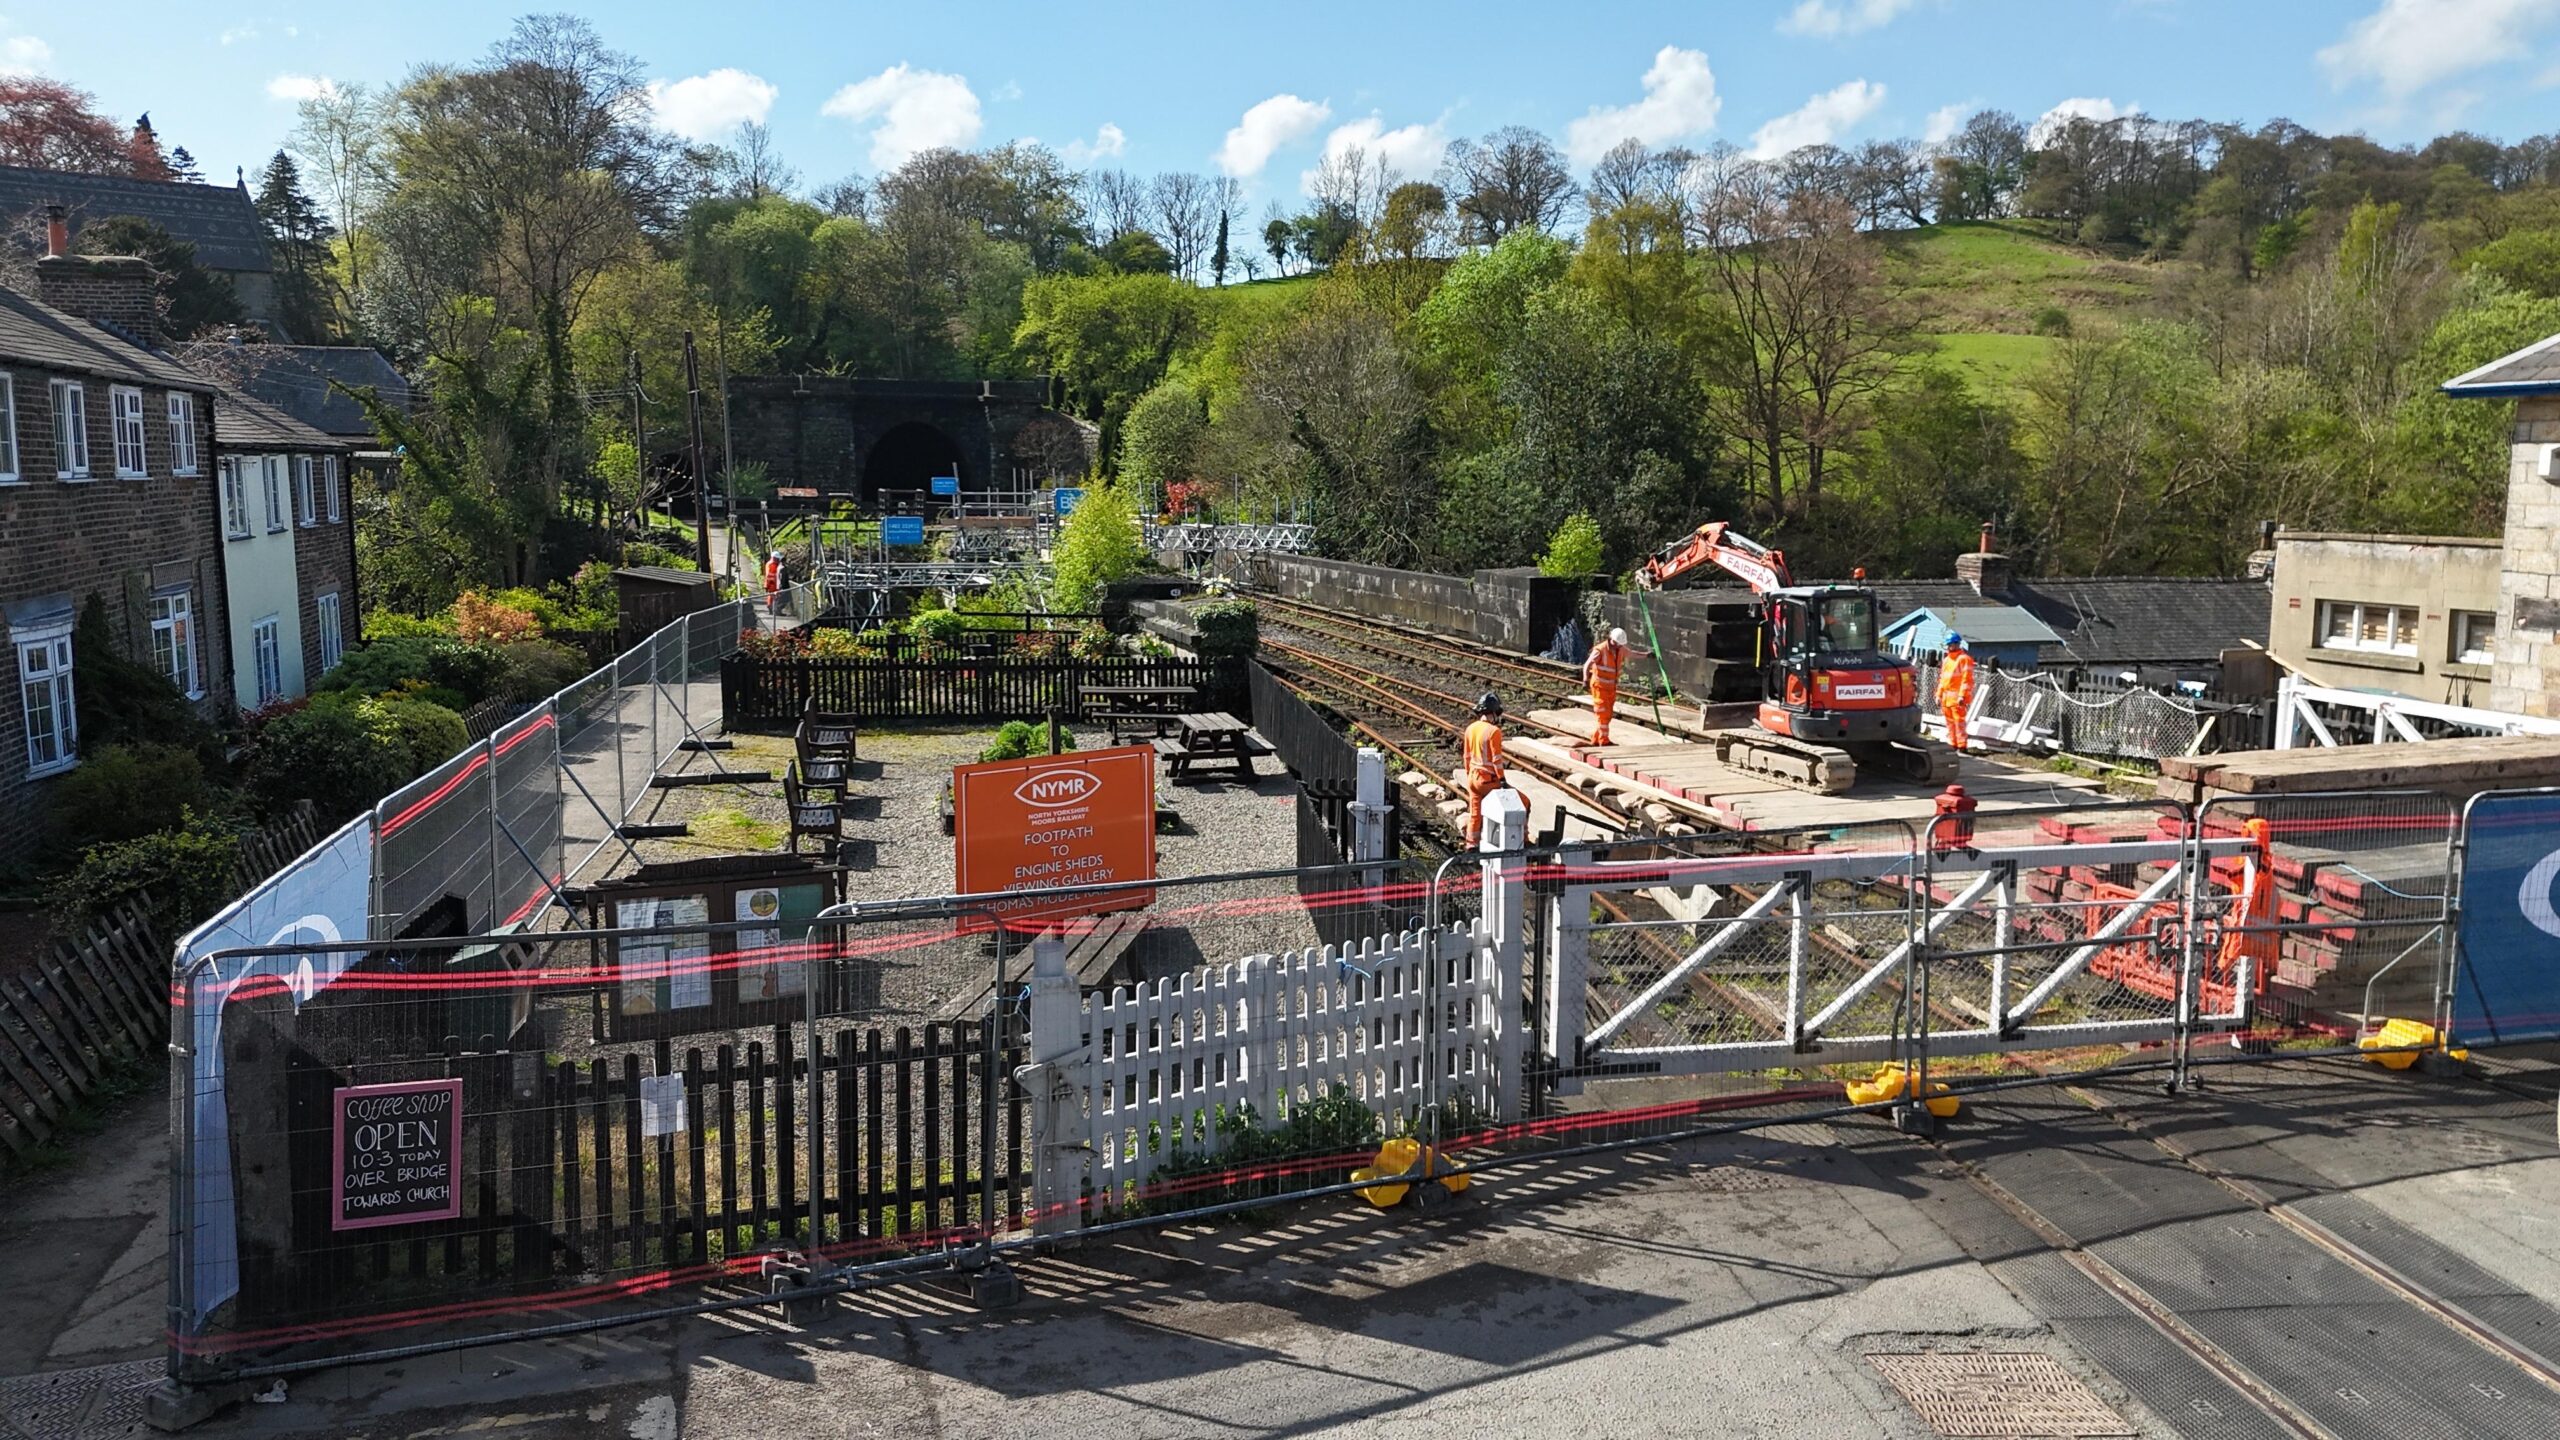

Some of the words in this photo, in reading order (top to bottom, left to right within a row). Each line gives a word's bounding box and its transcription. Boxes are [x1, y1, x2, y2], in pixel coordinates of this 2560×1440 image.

[1727, 557, 1772, 587] FAIRFAX
[1838, 688, 1882, 696] FAIRFAX
[1032, 778, 1086, 799] NYMR
[1028, 811, 1051, 820] NORTH
[1053, 806, 1089, 817] YORKSHIRE
[1032, 817, 1056, 826] MOORS
[1057, 813, 1086, 823] RAILWAY
[1024, 826, 1093, 845] FOOTPATH
[1050, 845, 1069, 856] TO
[1015, 861, 1062, 878] ENGINE
[1065, 855, 1103, 870] SHEDS
[1003, 877, 1059, 892] VIEWING
[1062, 868, 1114, 886] GALLERY
[355, 1120, 438, 1151] OPEN
[353, 1151, 393, 1169] 10-3
[400, 1149, 441, 1163] TODAY
[345, 1171, 389, 1189] OVER
[397, 1164, 447, 1182] BRIDGE
[343, 1190, 401, 1211] TOWARDS
[407, 1185, 450, 1202] CHURCH
